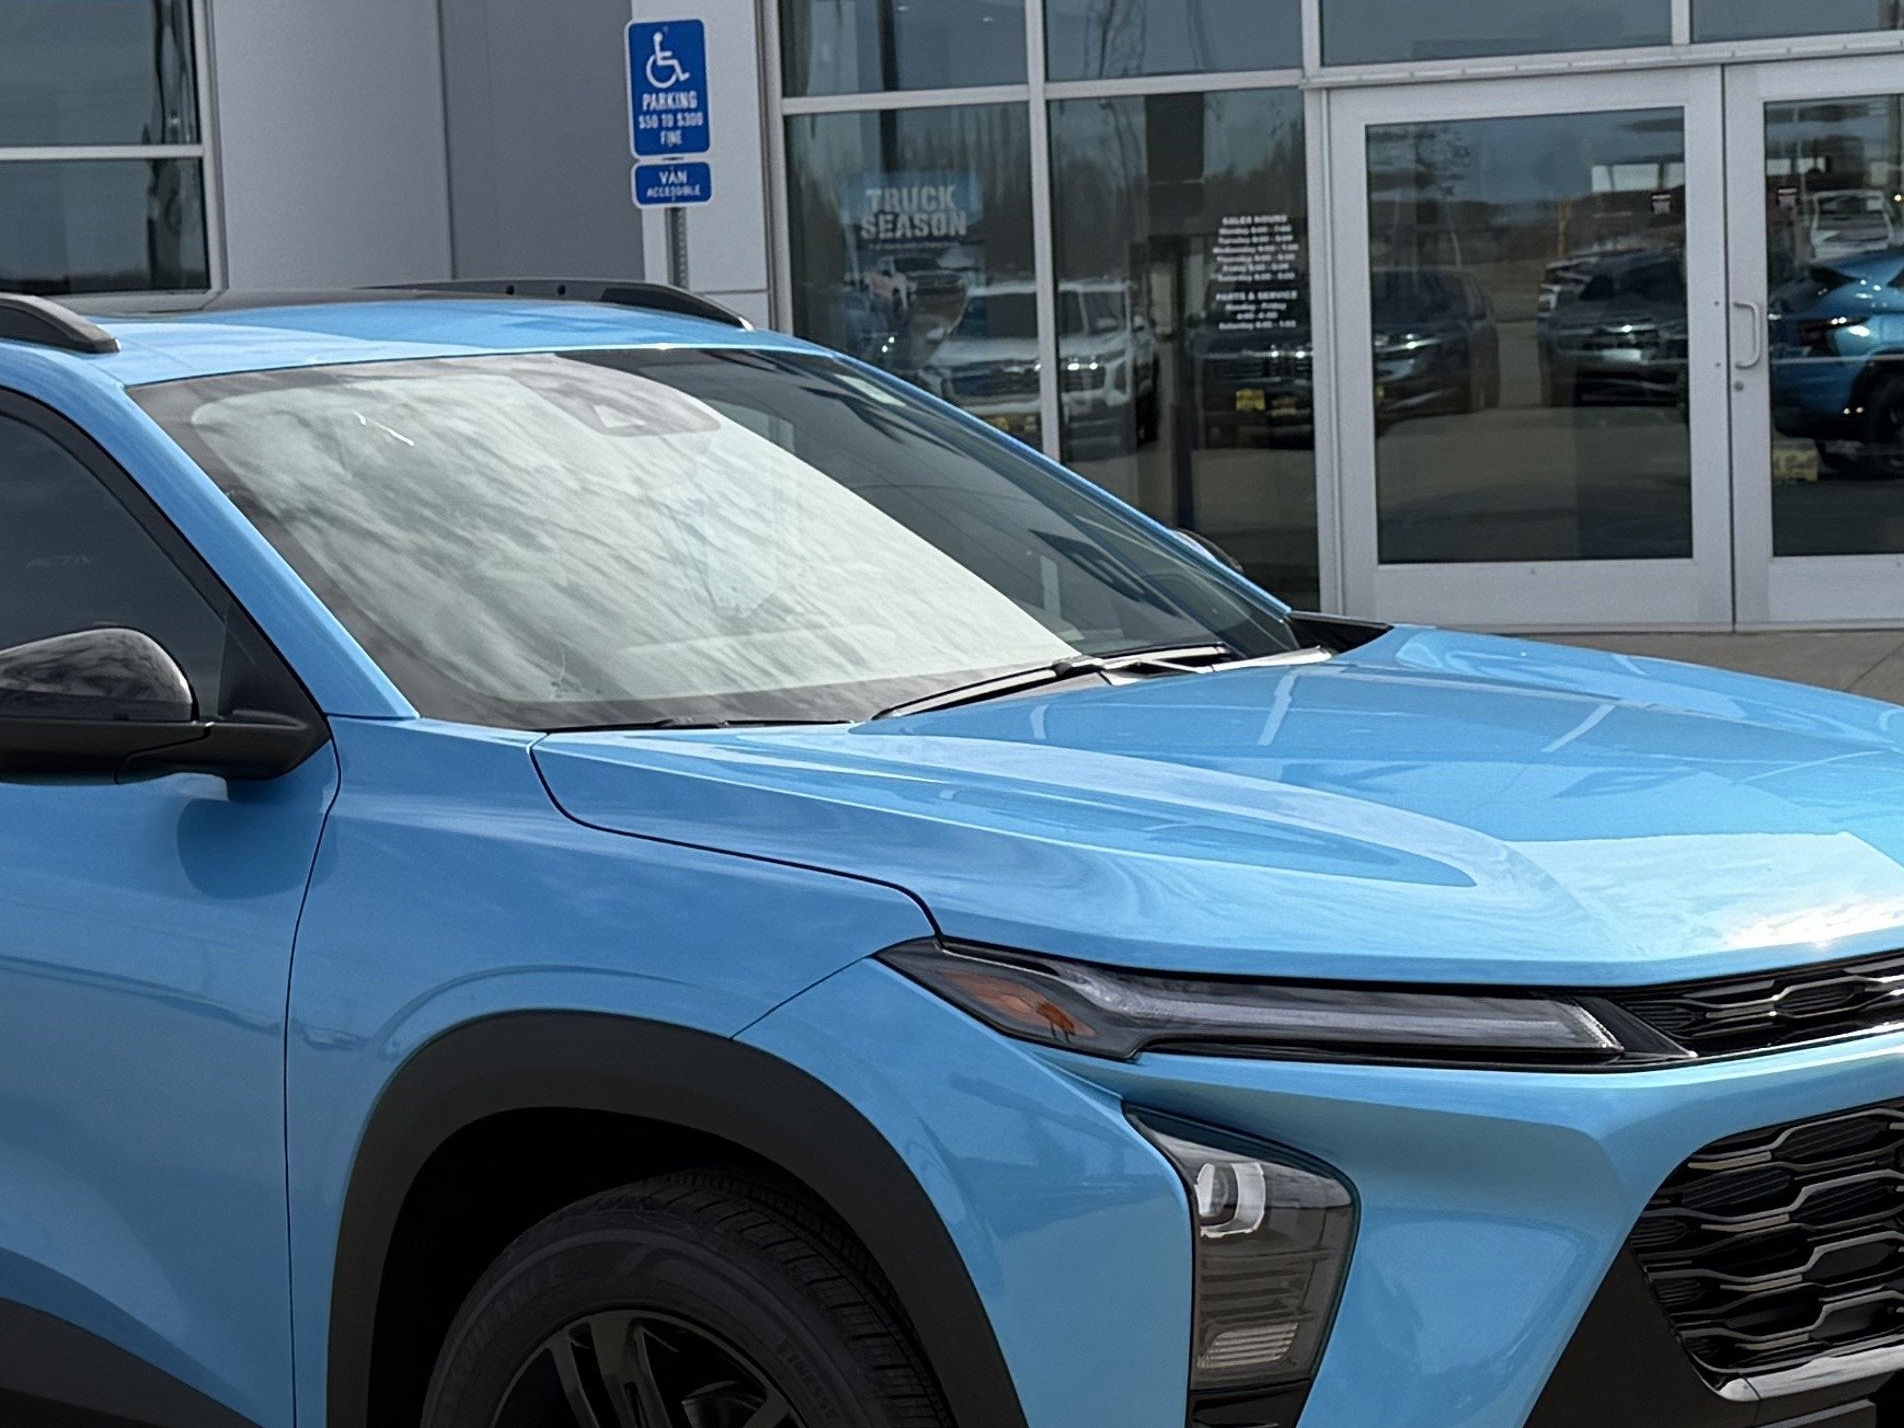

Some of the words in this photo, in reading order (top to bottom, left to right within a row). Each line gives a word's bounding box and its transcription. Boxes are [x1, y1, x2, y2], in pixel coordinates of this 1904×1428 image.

[642, 91, 698, 111] PARKING
[638, 113, 658, 129] $50
[661, 113, 674, 128] TO
[660, 129, 682, 146] FINE
[659, 170, 688, 185] VAN
[646, 184, 701, 198] ACCESSIBLE
[865, 184, 956, 213] TRUCK
[860, 210, 967, 240] SEASON
